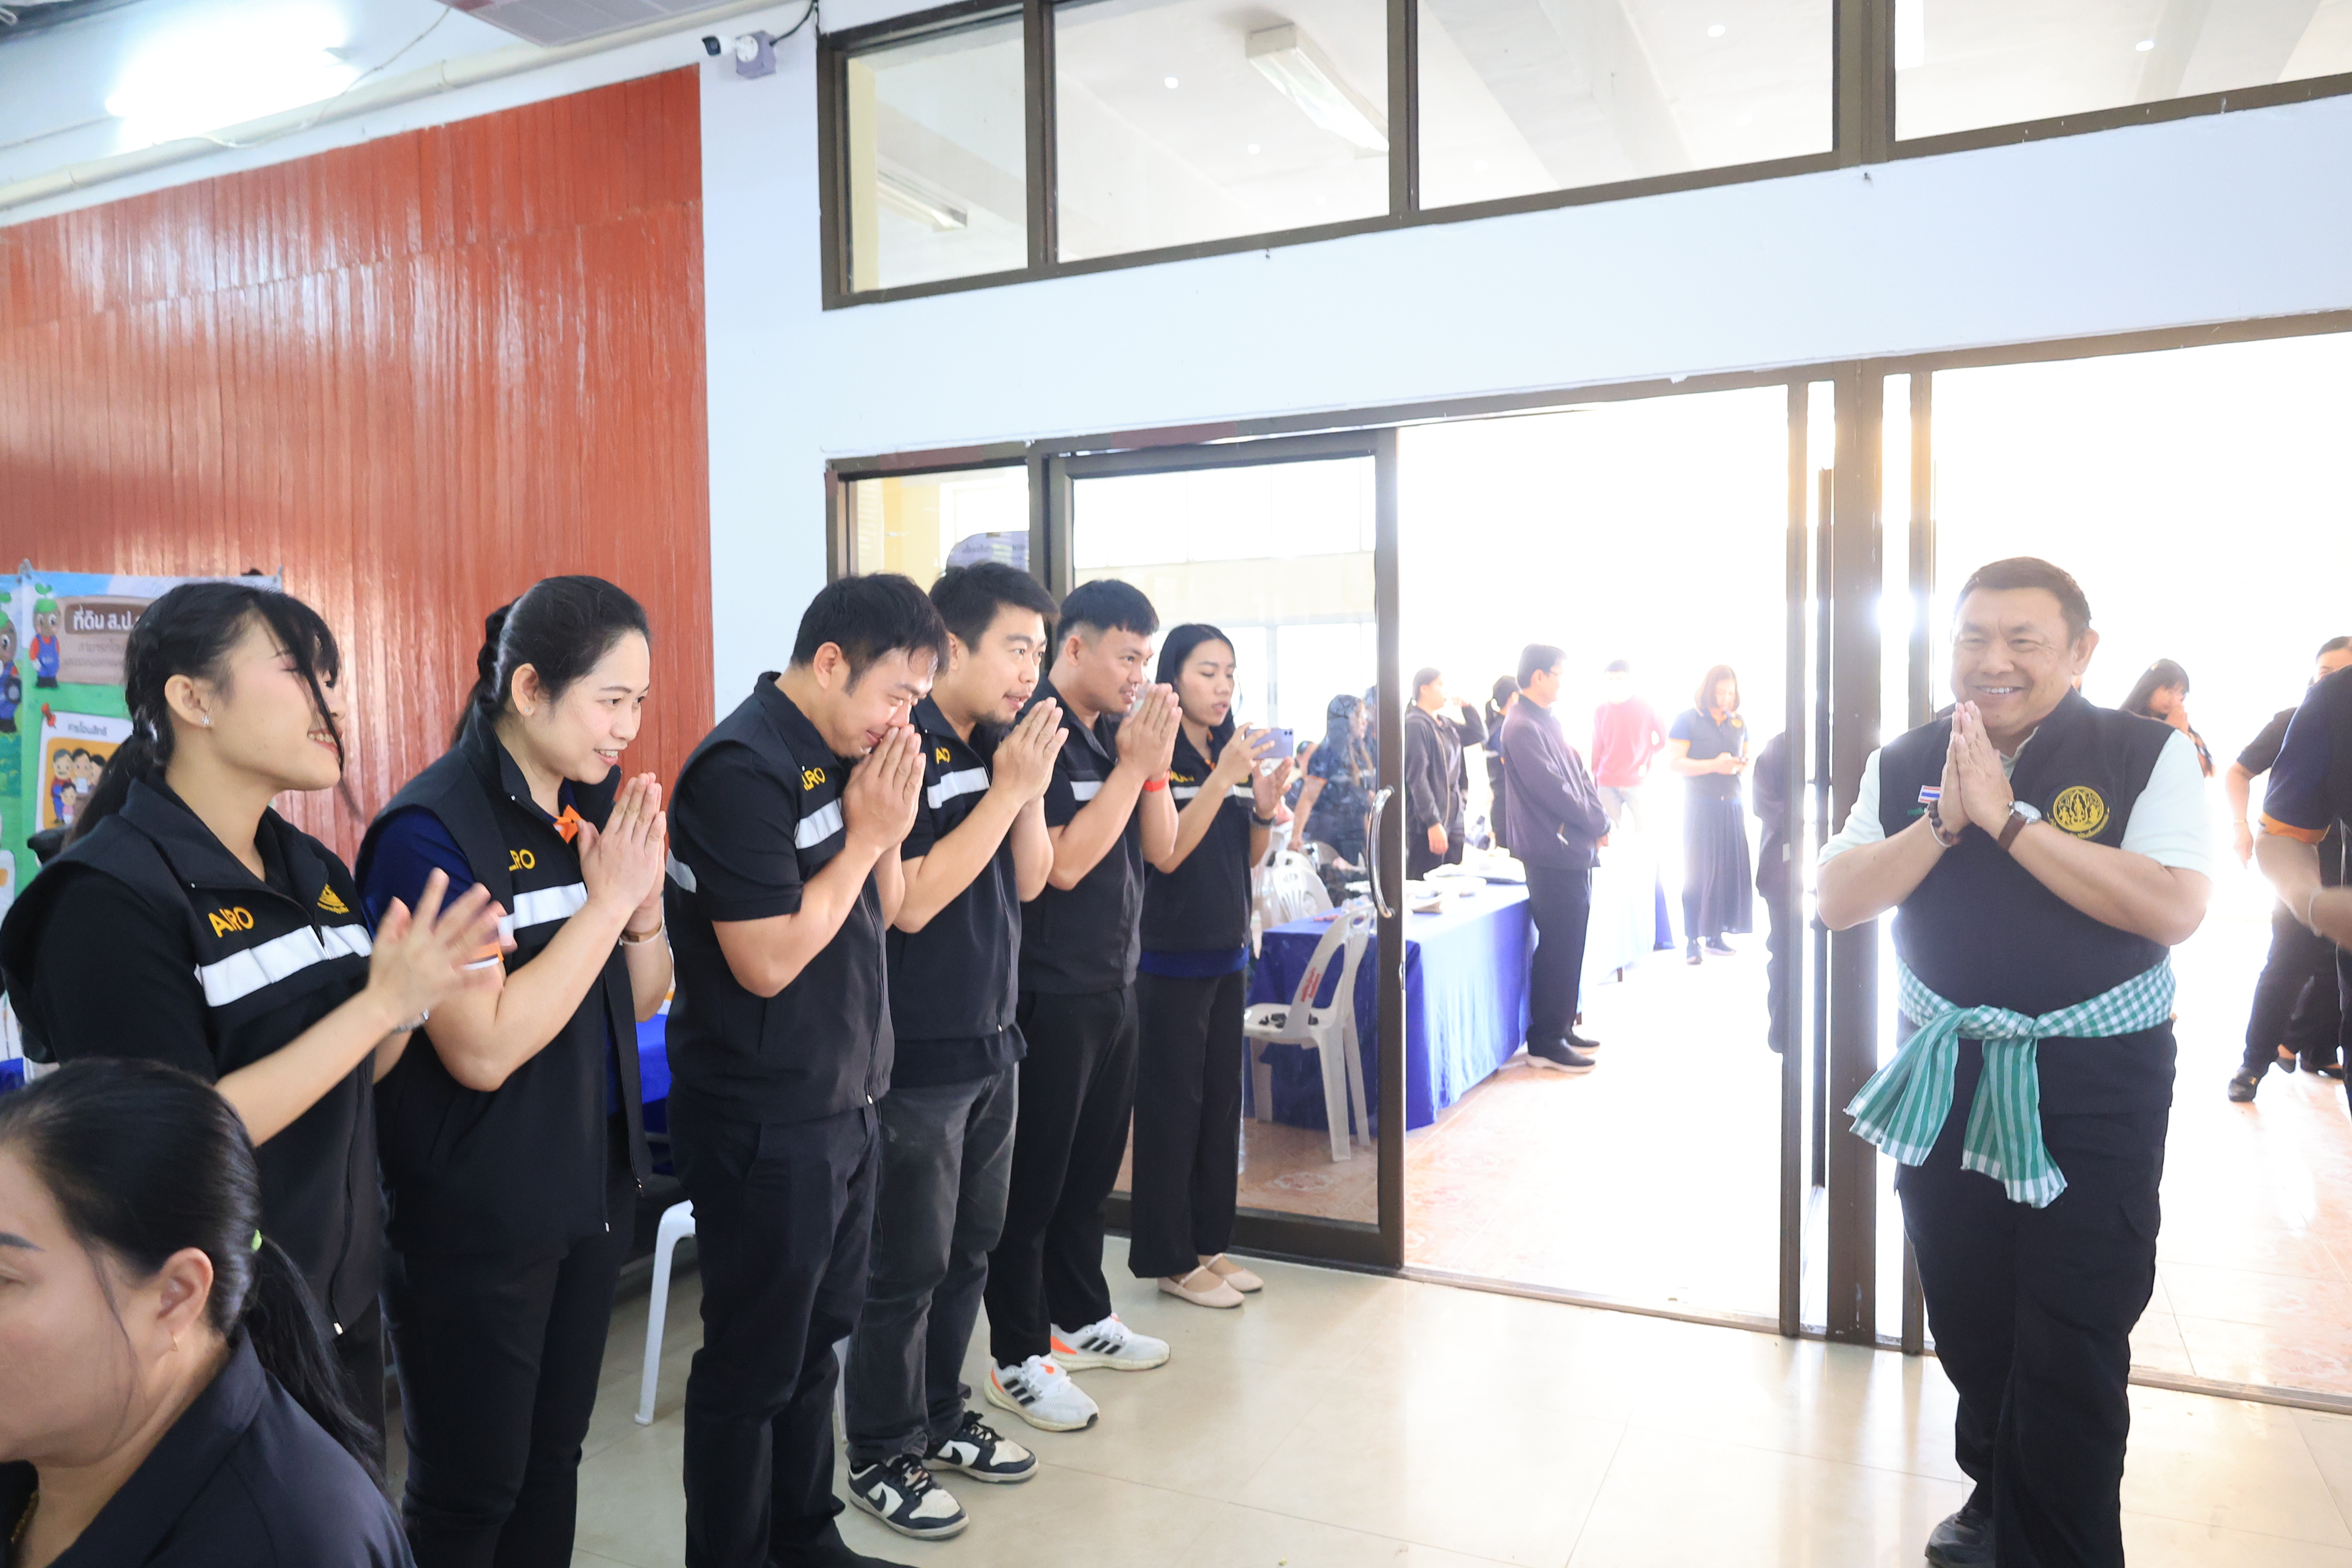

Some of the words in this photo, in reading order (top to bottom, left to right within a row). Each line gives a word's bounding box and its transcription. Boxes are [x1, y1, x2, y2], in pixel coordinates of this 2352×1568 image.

[73, 604, 104, 631] ที่ดิน
[107, 610, 141, 631] ส.ป.
